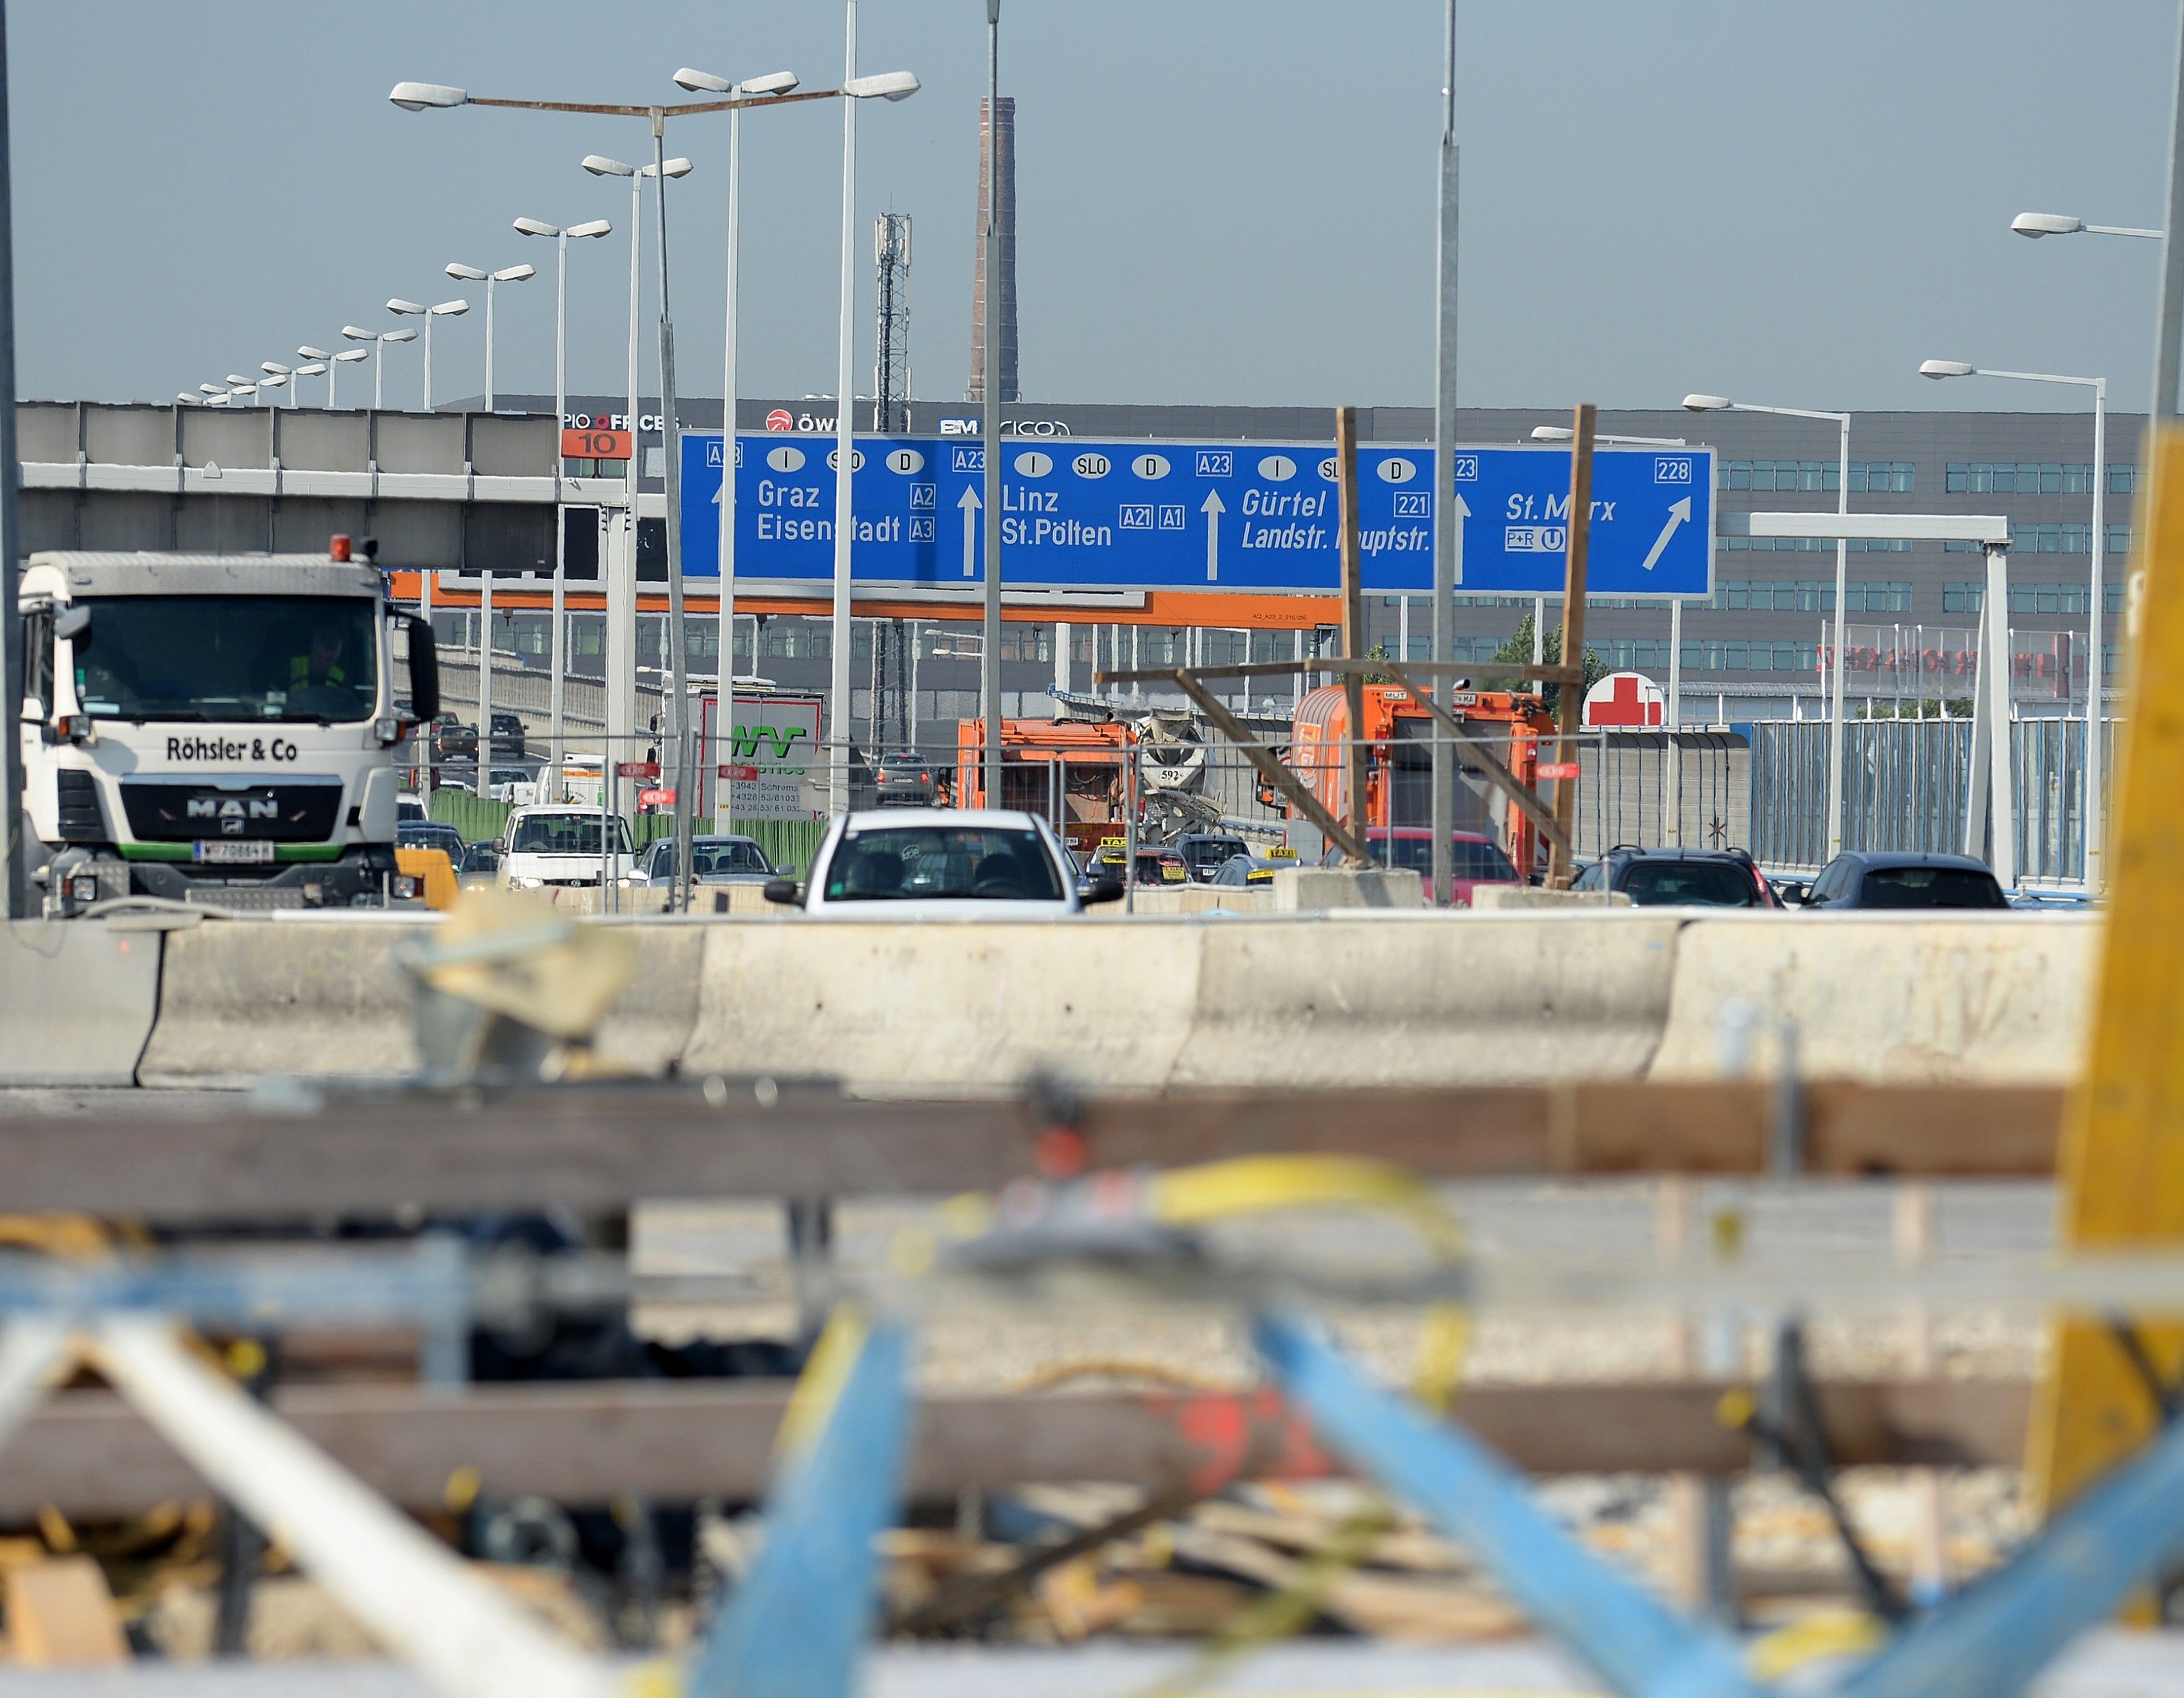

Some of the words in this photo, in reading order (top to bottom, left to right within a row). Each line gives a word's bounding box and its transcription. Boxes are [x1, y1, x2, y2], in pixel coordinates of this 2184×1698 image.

[578, 433, 617, 454] 10
[709, 446, 741, 463] A3
[784, 450, 788, 468] I
[831, 452, 860, 469] SO
[900, 453, 911, 470] D
[956, 450, 985, 469] A23
[1031, 455, 1035, 473] I
[1077, 458, 1106, 474] SLO
[1145, 458, 1157, 476] D
[1198, 455, 1229, 473] A23
[1275, 459, 1280, 477] I
[1323, 461, 1339, 478] SL
[1390, 462, 1402, 479] D
[1456, 459, 1476, 477] 23
[1658, 461, 1689, 480] 228
[758, 479, 820, 508] Graz
[912, 487, 934, 506] A2
[1003, 484, 1059, 513] Linz
[1242, 489, 1327, 517] Gürtel
[1398, 496, 1426, 514] 221
[1544, 493, 1617, 521] Mrx
[1123, 508, 1150, 526] A21
[1163, 508, 1181, 526] A1
[758, 513, 901, 542] Eisentadt
[911, 520, 933, 538] A3
[1241, 521, 1328, 549] Landstr.
[1335, 523, 1431, 558] uptstr.
[167, 737, 247, 761] Röhsler
[252, 738, 265, 760] &
[271, 738, 298, 762] Co
[187, 799, 278, 818] MAN
